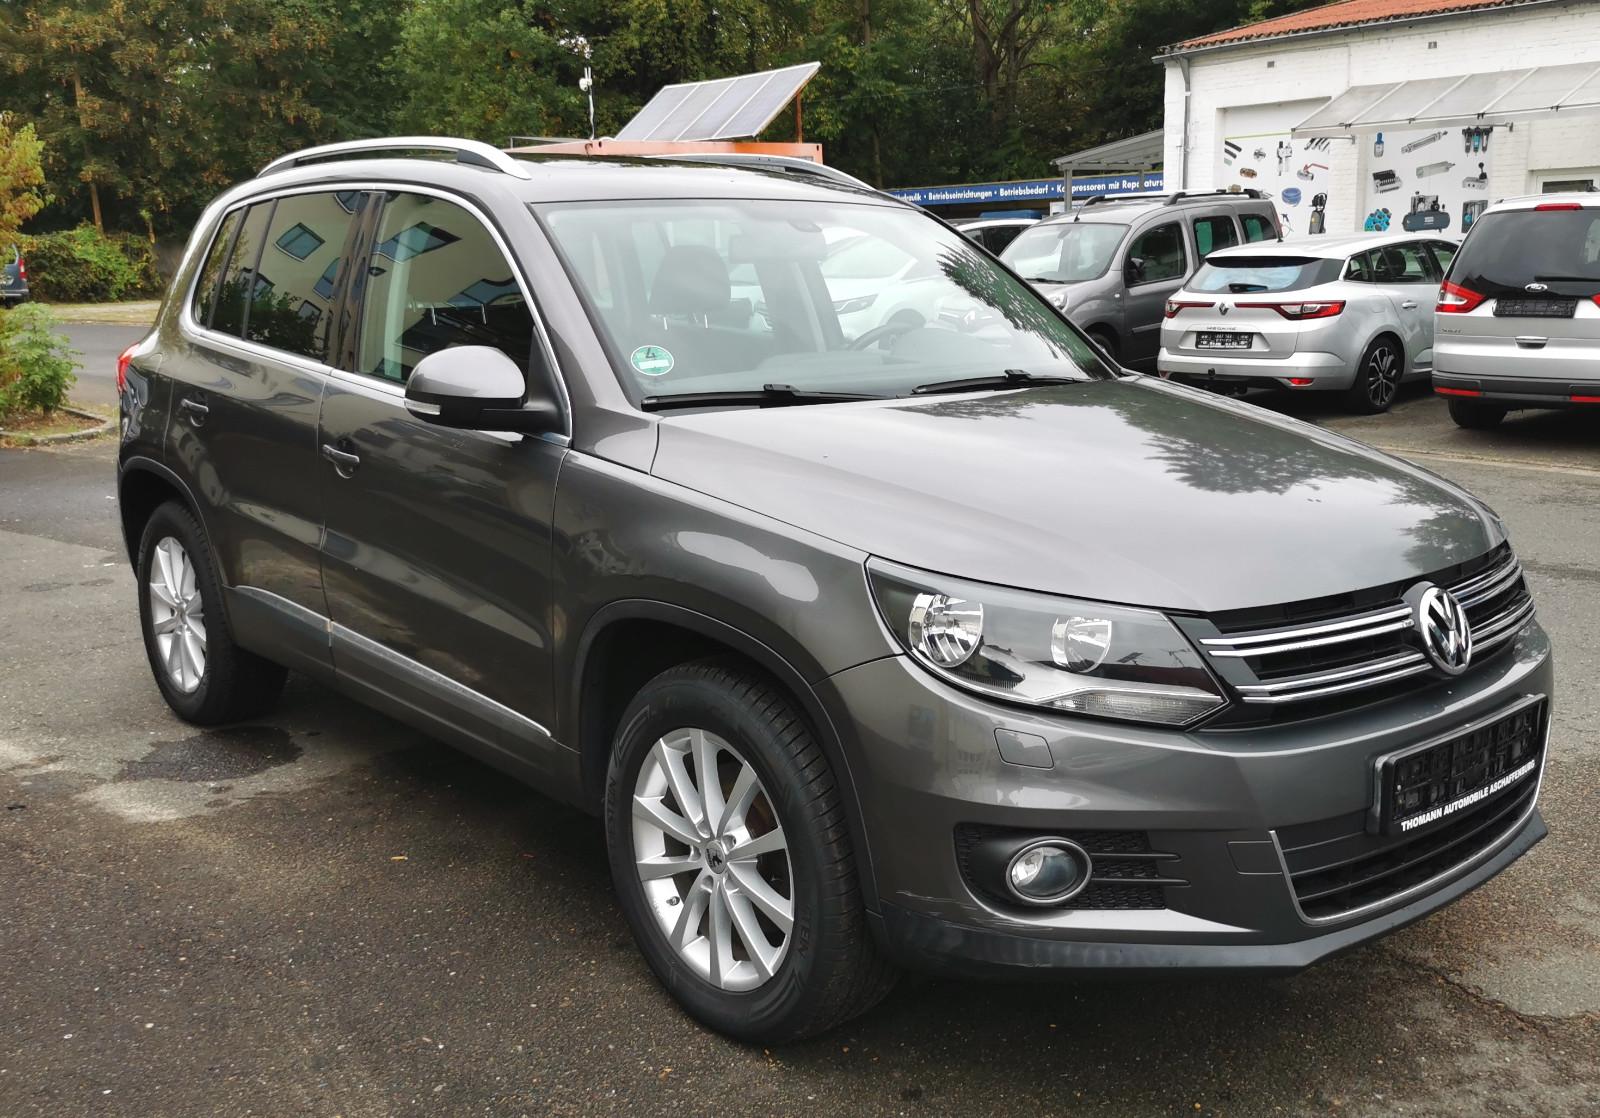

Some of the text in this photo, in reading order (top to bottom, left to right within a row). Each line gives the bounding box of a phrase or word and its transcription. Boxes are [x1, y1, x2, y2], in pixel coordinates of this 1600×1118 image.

[928, 190, 993, 201] Betriebseinrichtungen
[1000, 184, 1049, 197] Betriebsbedarf
[1056, 183, 1106, 194] Kopressoren
[1108, 180, 1120, 190] mit
[1401, 759, 1536, 832] THOMANN AUTOMOBILE ASCHAFFENBURG
